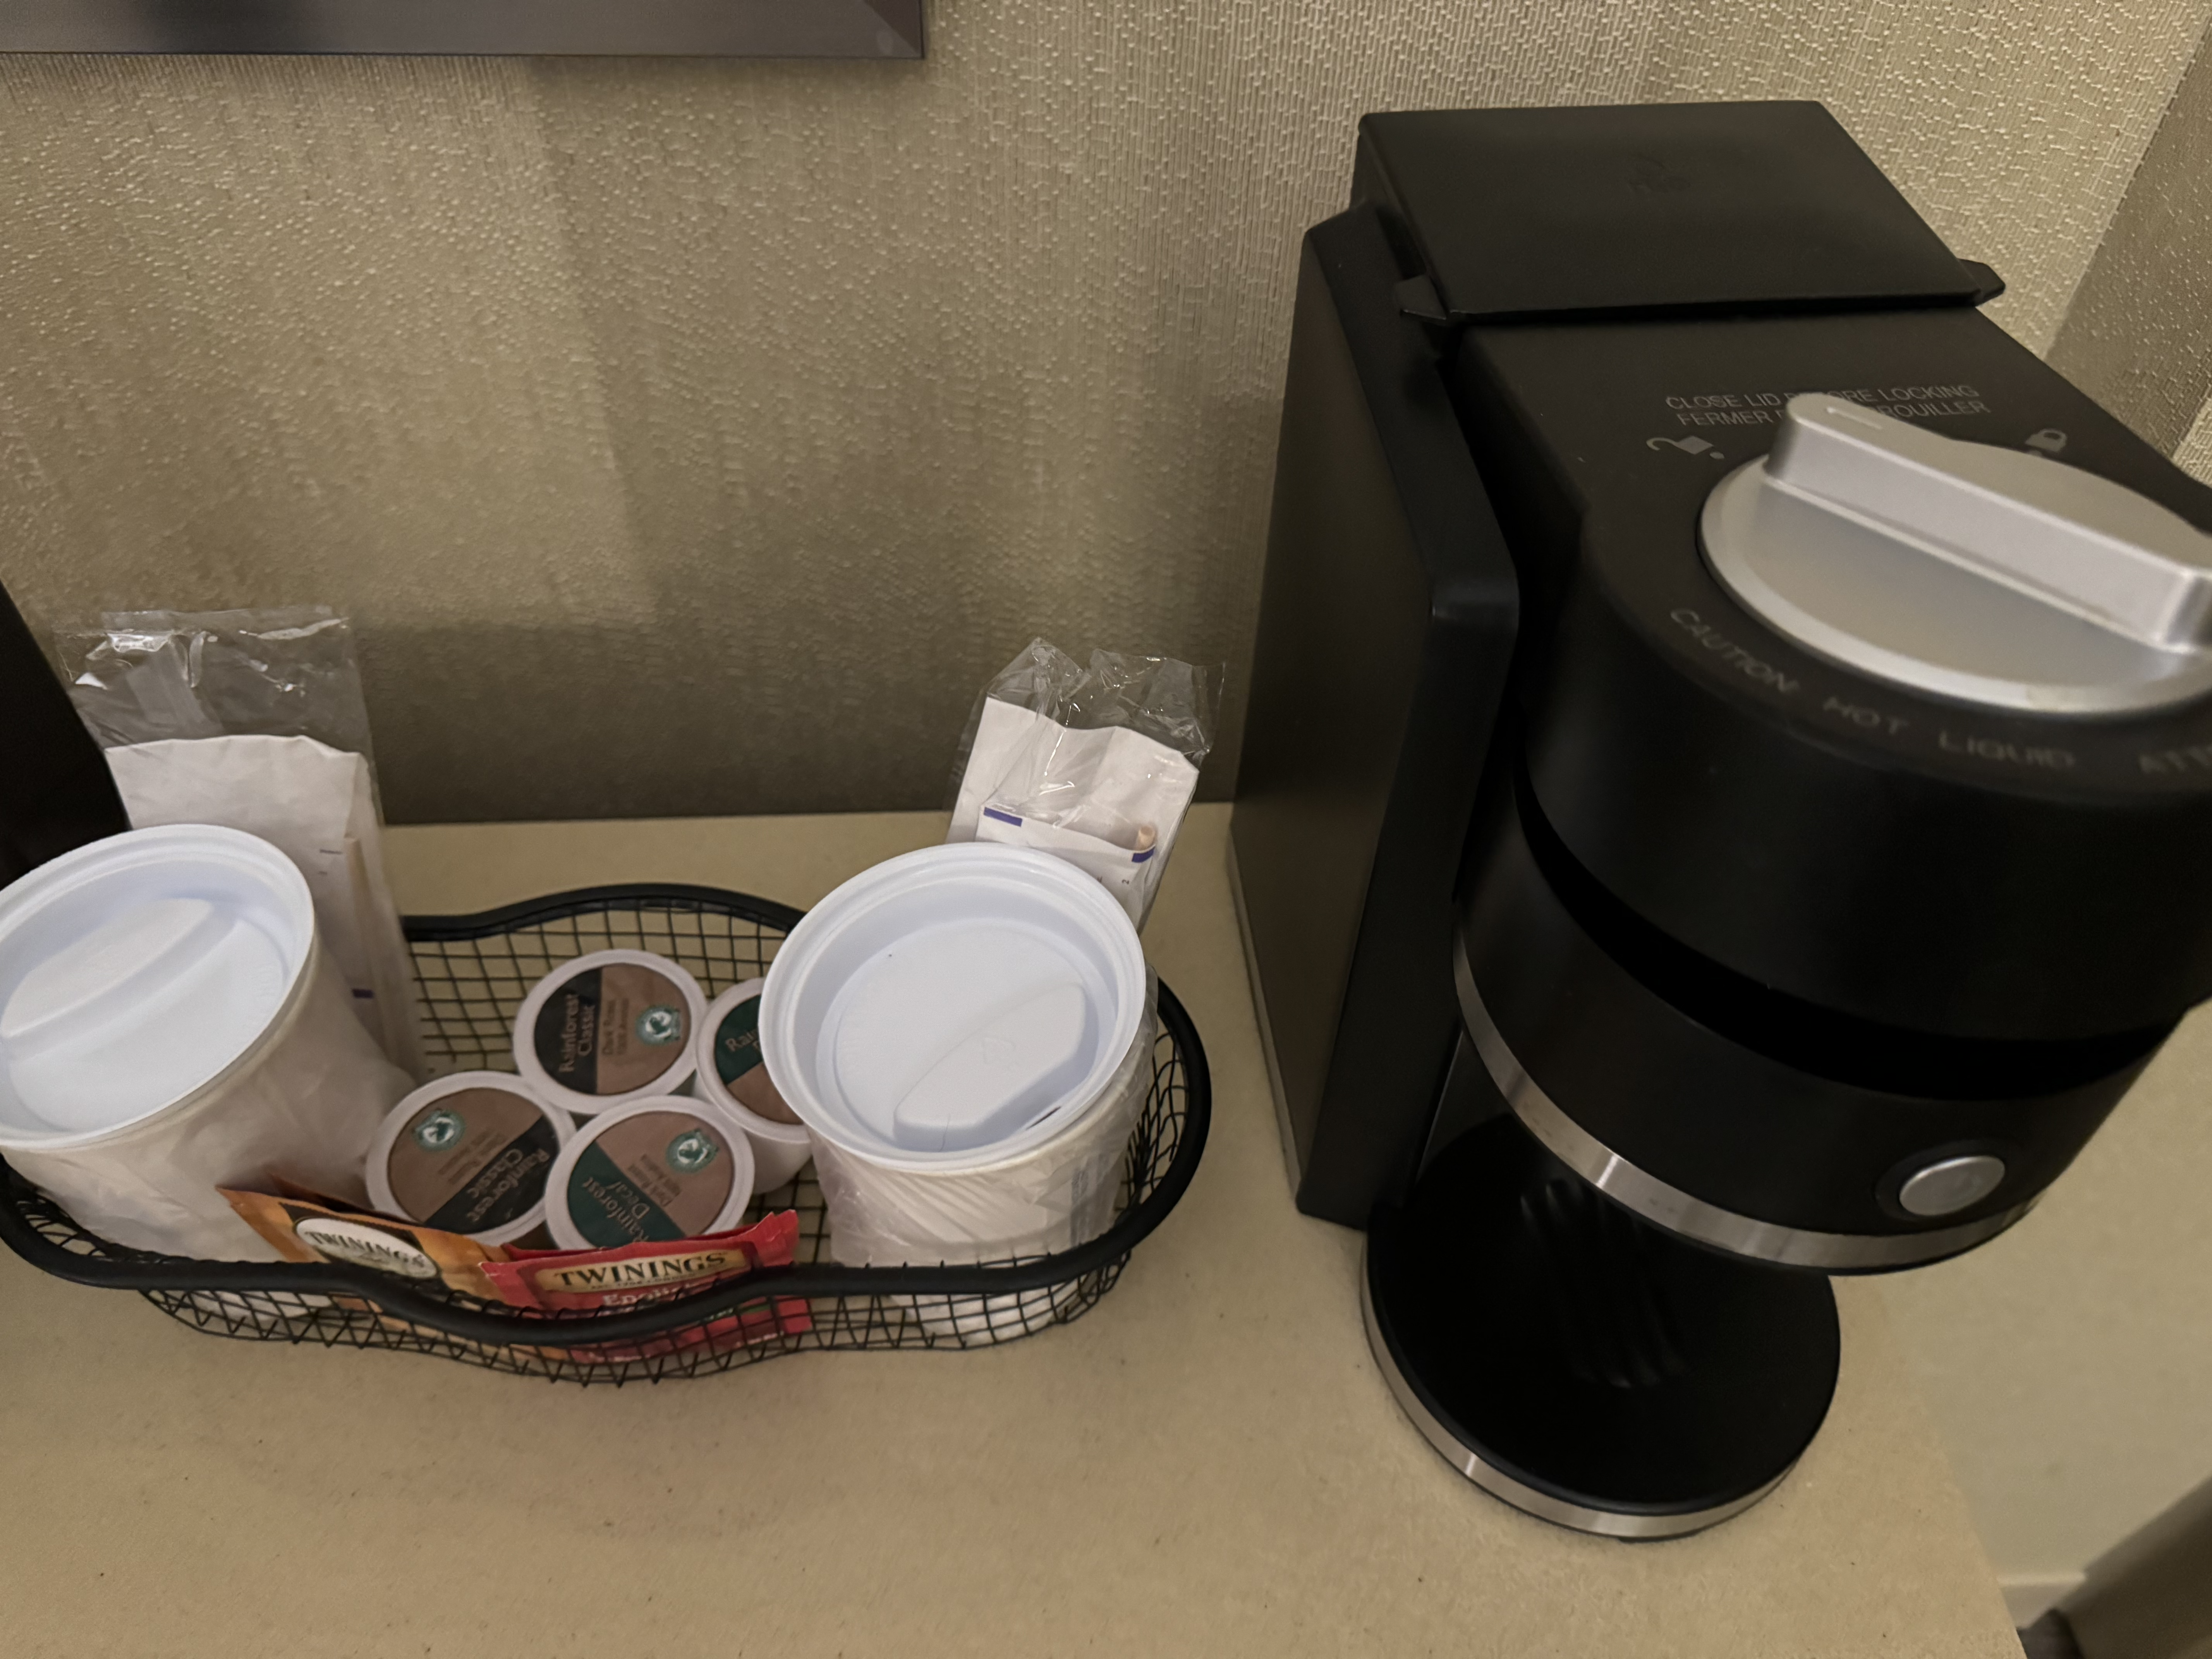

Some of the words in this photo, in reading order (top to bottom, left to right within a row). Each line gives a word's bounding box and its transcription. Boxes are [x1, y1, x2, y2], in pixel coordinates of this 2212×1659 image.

[1665, 394, 1743, 409] CLOSE
[1744, 393, 1783, 407] LID
[1878, 385, 1980, 401] LOCKING
[1676, 410, 1774, 426] FERMER
[1877, 393, 1991, 417] ROUILLER
[1670, 608, 1800, 692] CAUTION
[1822, 697, 1909, 734] HOT
[1939, 731, 2076, 768] LIQUID
[558, 993, 579, 1072] Rainforest
[577, 1005, 596, 1056] Classic
[466, 1148, 550, 1222] Rainforest
[582, 1176, 649, 1242] Rainforest
[605, 1181, 650, 1220] Decaf
[555, 1252, 727, 1286] TWININGS
